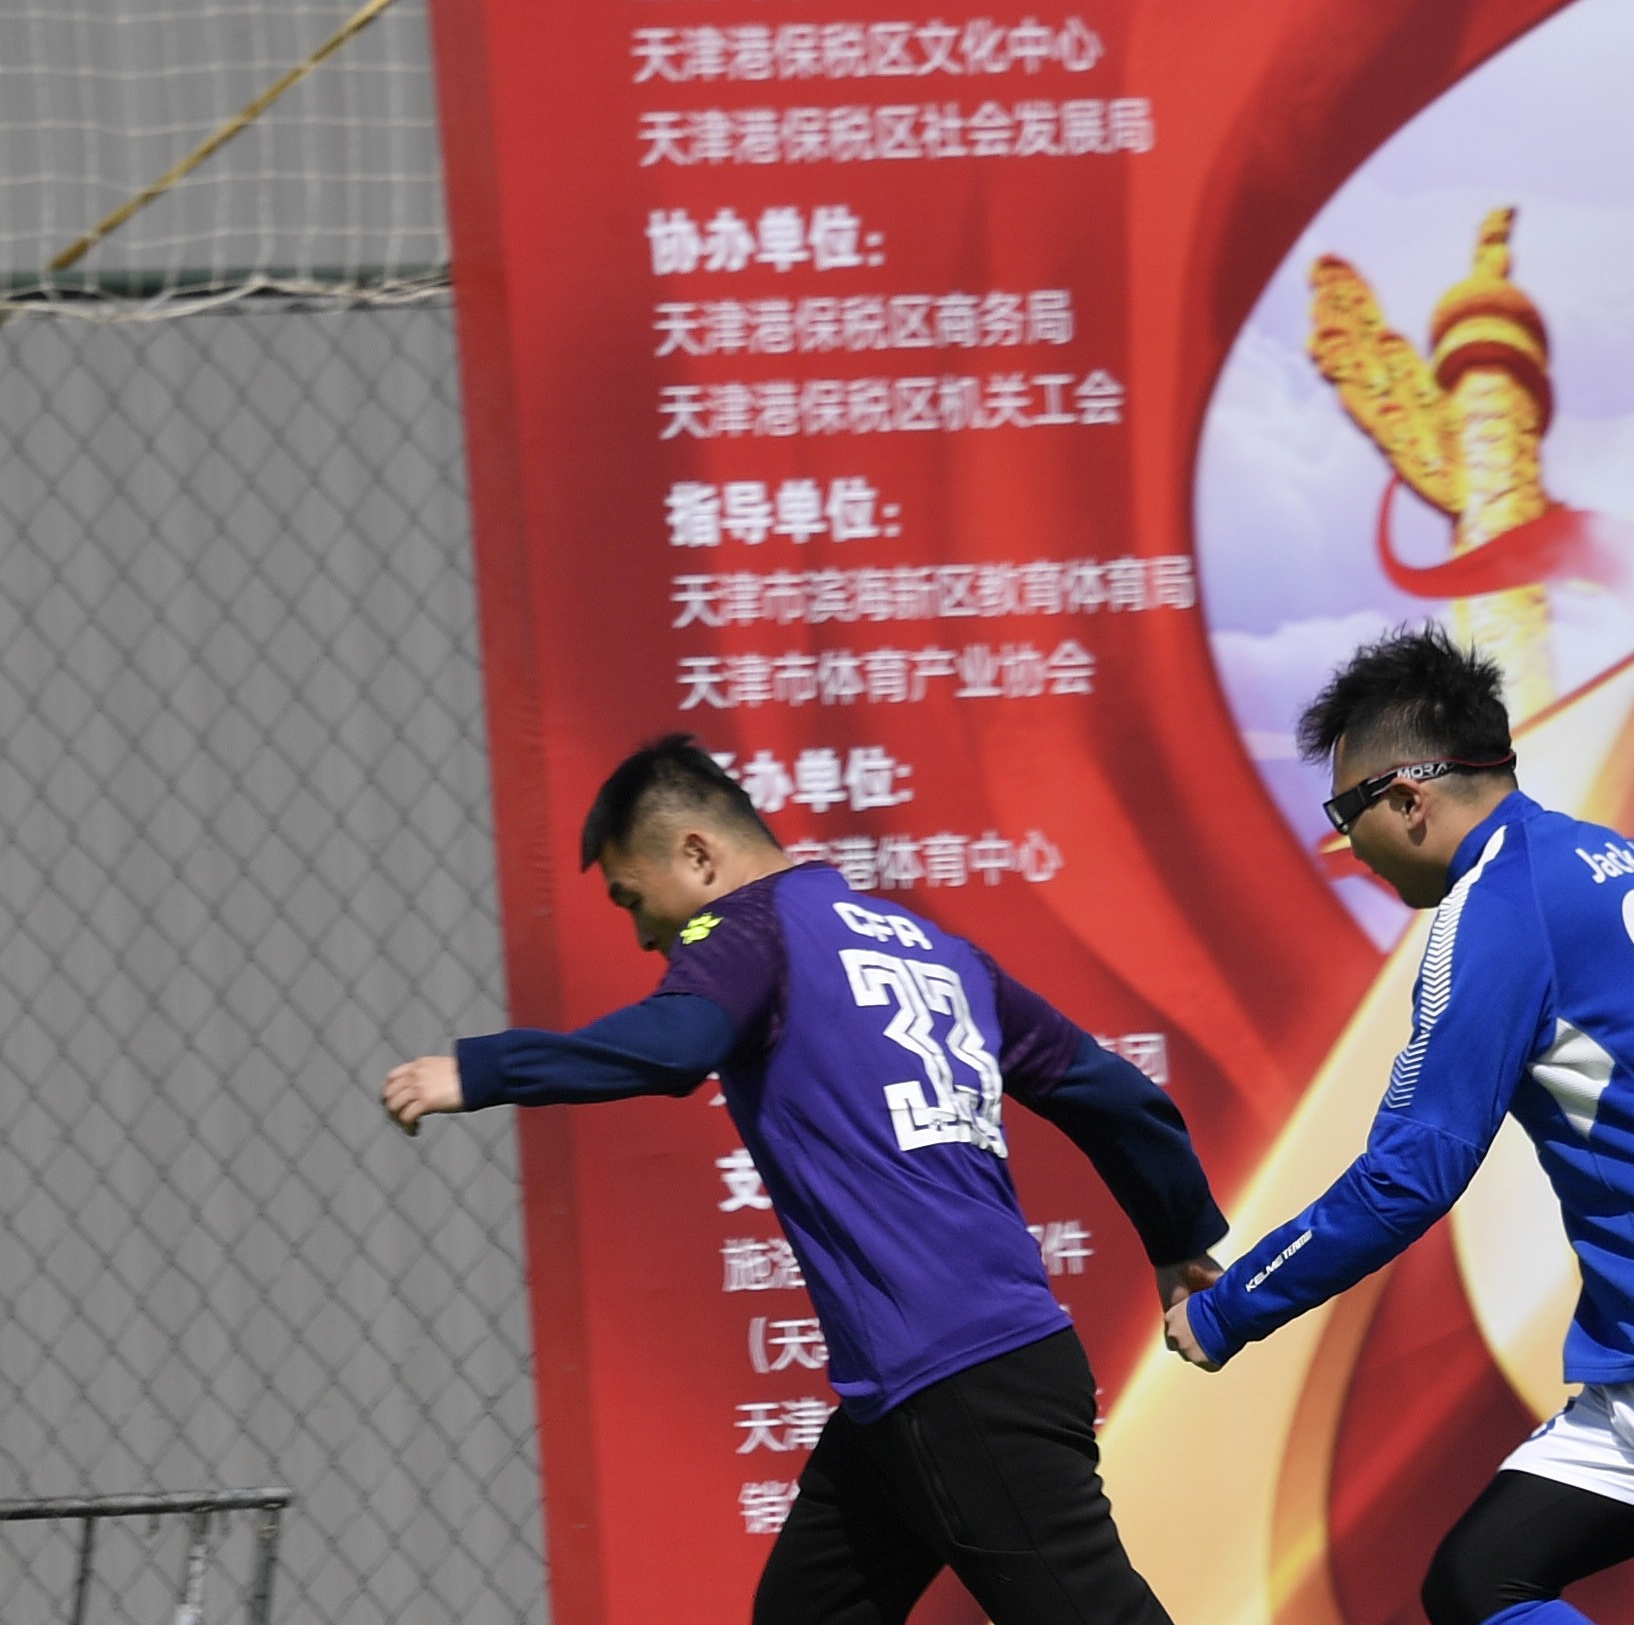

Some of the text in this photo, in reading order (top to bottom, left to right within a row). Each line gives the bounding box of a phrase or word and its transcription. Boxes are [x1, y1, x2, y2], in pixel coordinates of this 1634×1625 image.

[632, 18, 1104, 83] 天津港保税区文化中心
[638, 97, 1156, 167] 天津港保税区社会发展局
[647, 205, 884, 275] 协办单位：
[653, 289, 1076, 357] 天津港保税区商务局
[659, 369, 1125, 439] 天津港保税区机关工会
[664, 476, 901, 547] 指导单位：
[671, 554, 1195, 629] 天津市滨海新区教育体育局
[678, 639, 1096, 710] 天津市体育产业协会
[709, 745, 915, 814] 办单位：
[838, 948, 1008, 1158] 33
